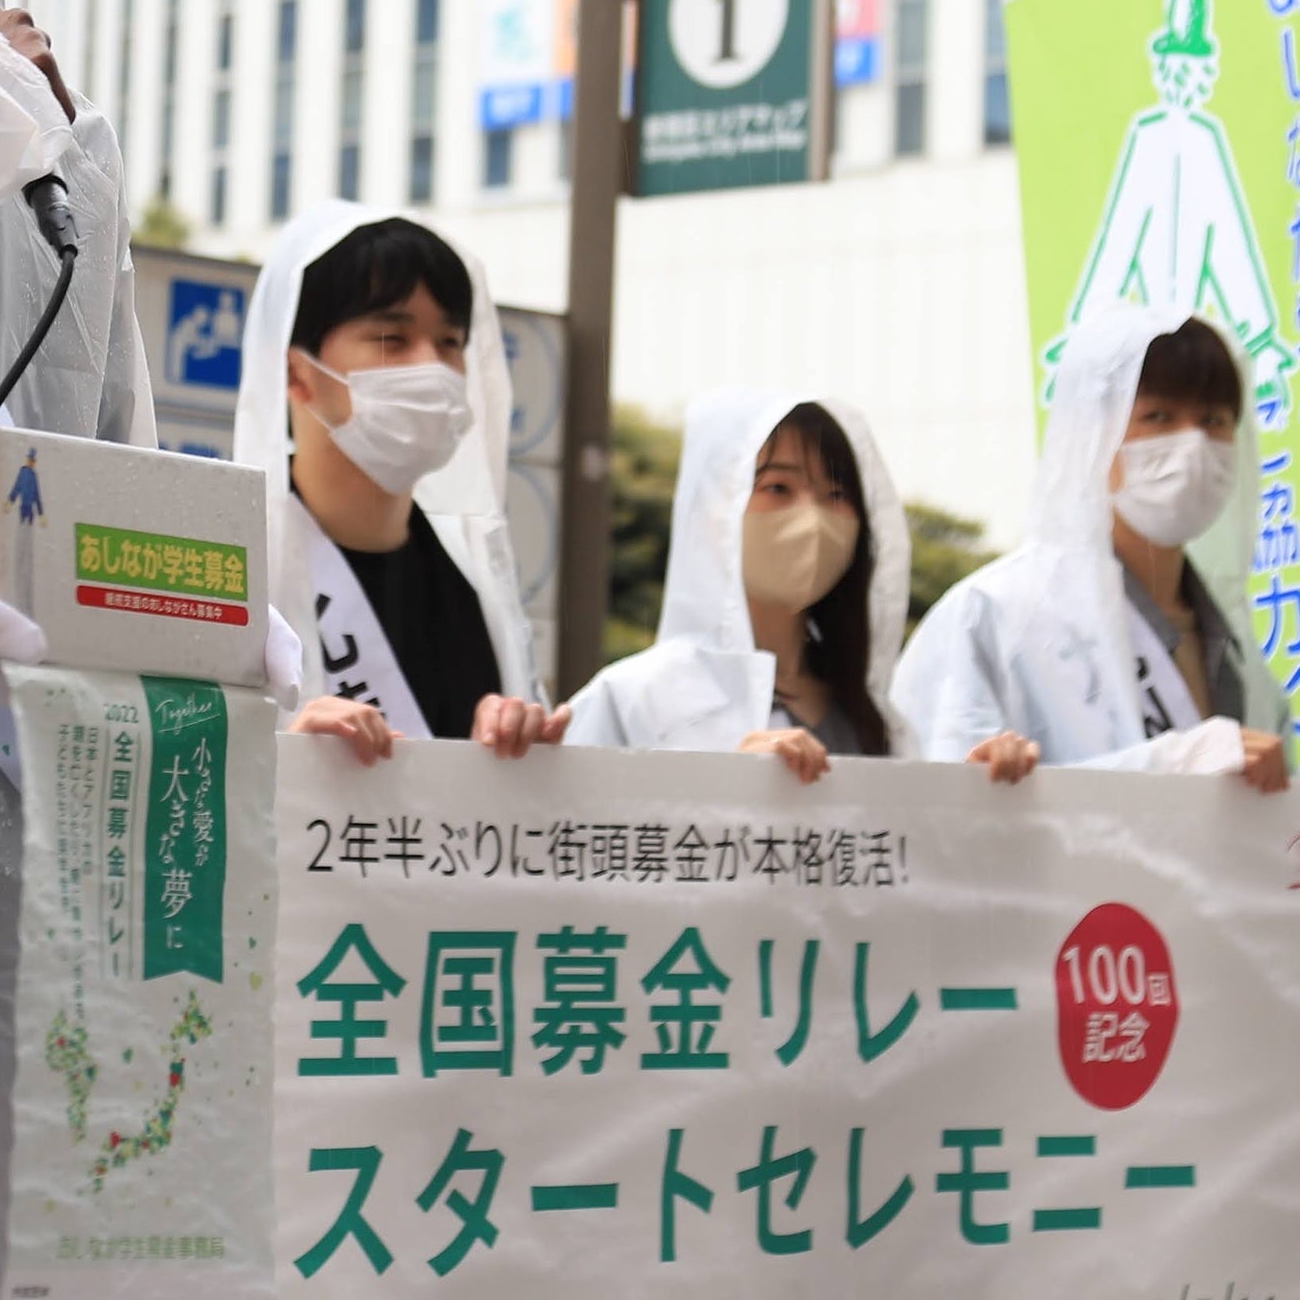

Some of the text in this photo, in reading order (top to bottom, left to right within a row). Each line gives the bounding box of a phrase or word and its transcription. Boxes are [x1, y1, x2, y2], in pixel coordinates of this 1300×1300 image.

[79, 534, 245, 593] あしなが学生募金
[104, 703, 140, 725] 2022
[107, 730, 134, 978] 全国募金リレー
[158, 755, 193, 950] 大きな夢に
[305, 813, 910, 889] 2年半ぶりに街頭募金が本格復活!
[295, 922, 1019, 1079] 全国募金リレー
[1061, 944, 1172, 1009] 100回
[1081, 1011, 1153, 1066] 記念
[293, 1124, 1197, 1280] スタートセレモニー
